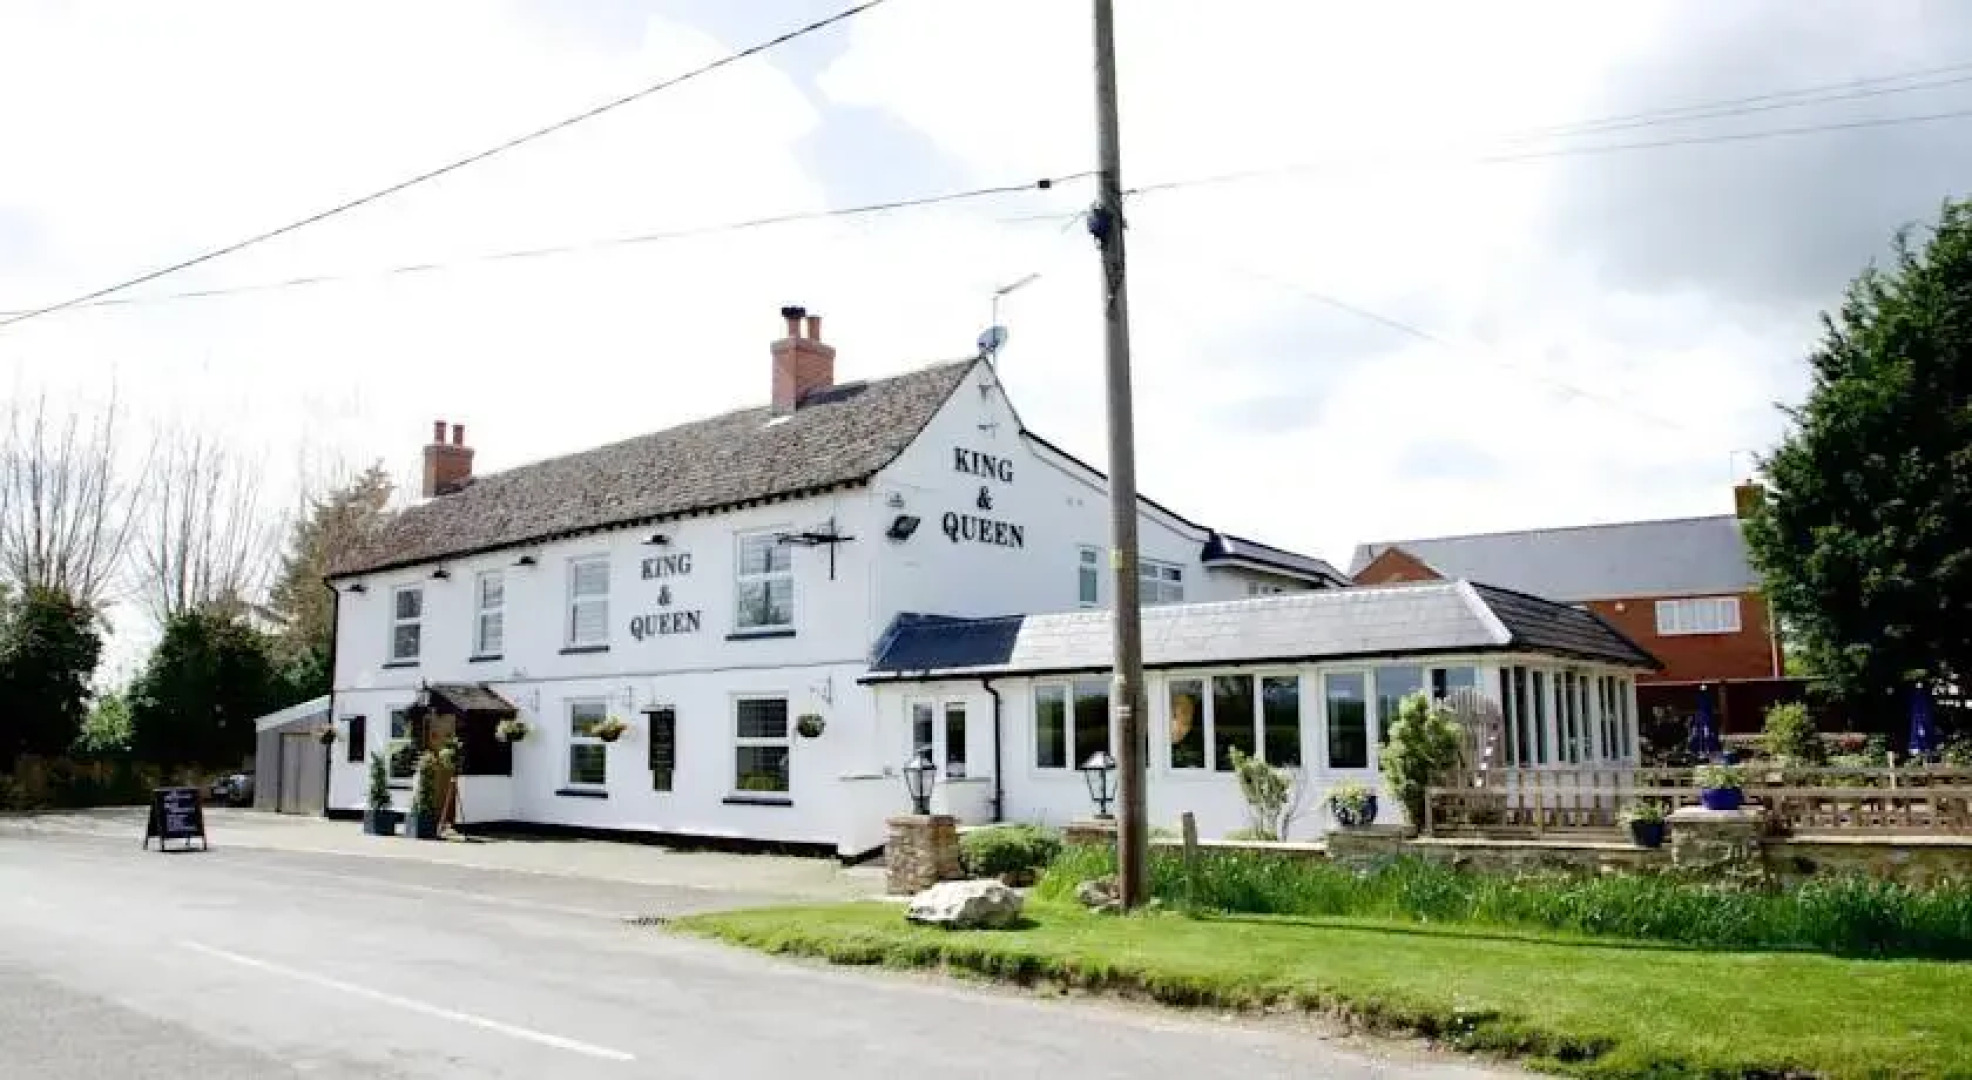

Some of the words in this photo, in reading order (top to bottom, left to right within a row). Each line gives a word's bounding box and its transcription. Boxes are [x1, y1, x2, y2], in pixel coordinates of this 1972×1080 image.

[954, 447, 1013, 482] KING
[977, 486, 993, 510] &
[942, 512, 1025, 548] QUEEN
[641, 554, 692, 580] KING
[657, 585, 671, 606] &
[630, 610, 702, 641] QUEEN
